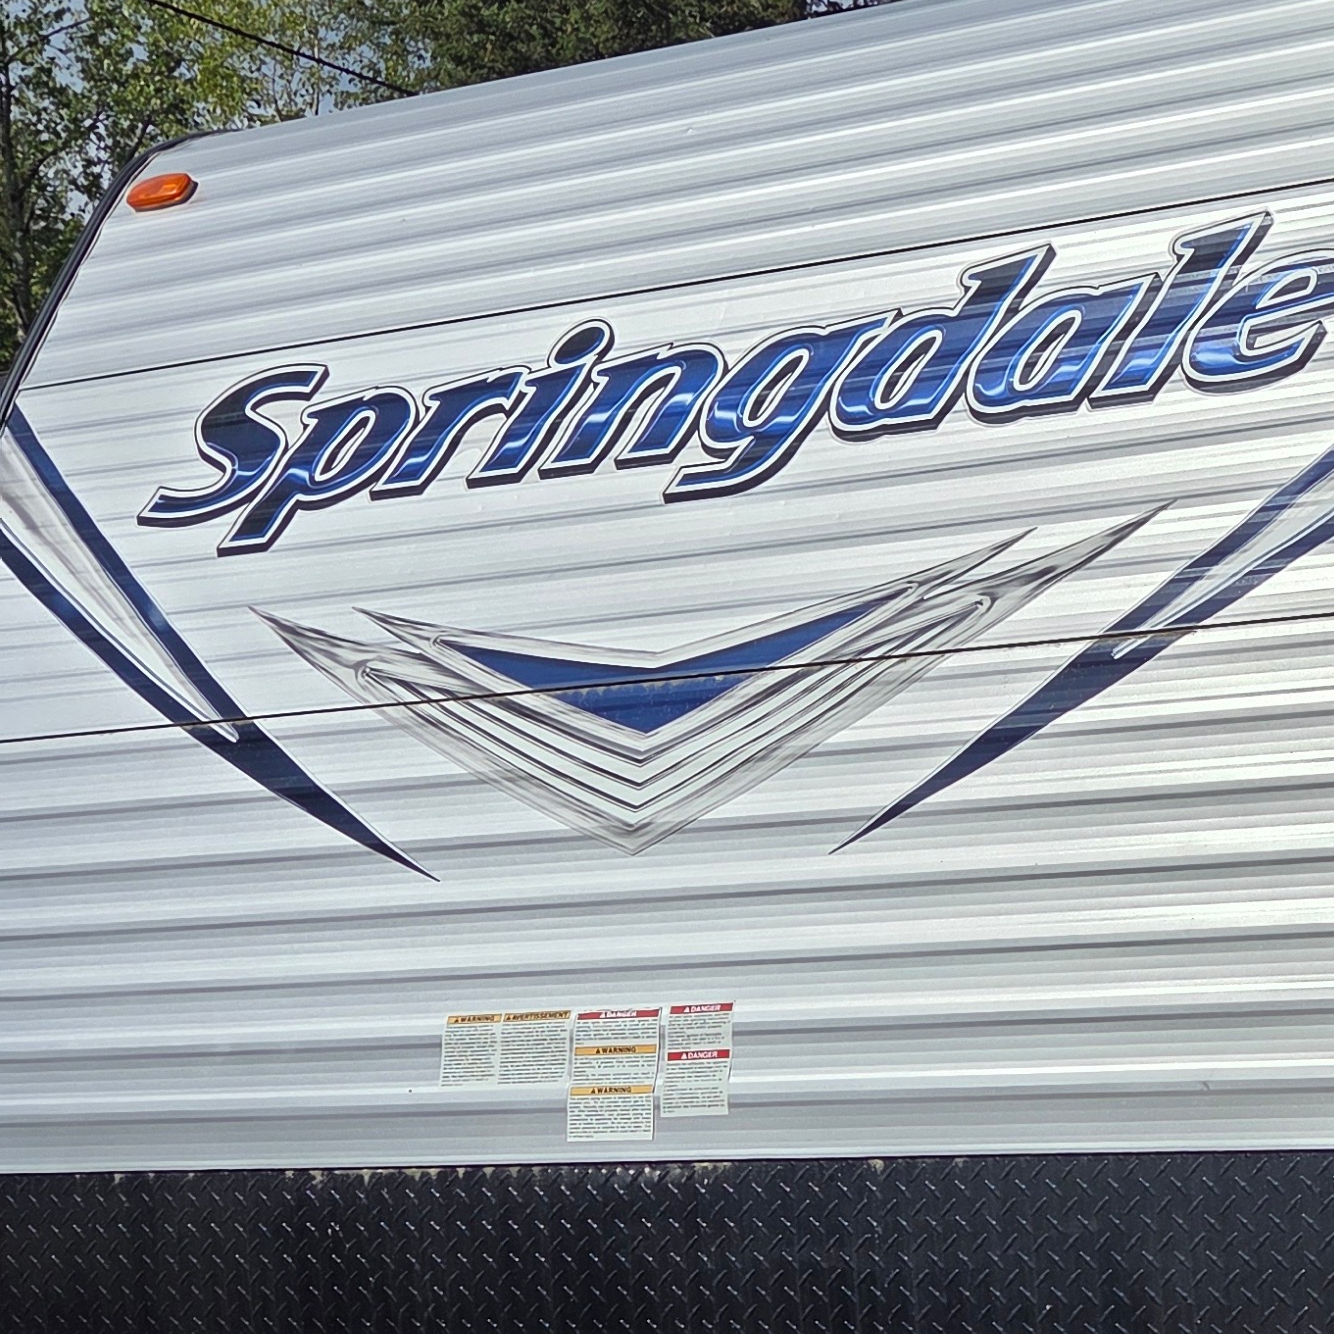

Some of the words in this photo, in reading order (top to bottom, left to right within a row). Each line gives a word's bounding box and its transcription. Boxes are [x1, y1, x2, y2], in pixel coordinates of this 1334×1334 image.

[691, 1005, 721, 1013] DANGER
[460, 1015, 495, 1023] WARNING
[602, 1046, 637, 1054] WARNING
[688, 1051, 718, 1059] DANGER
